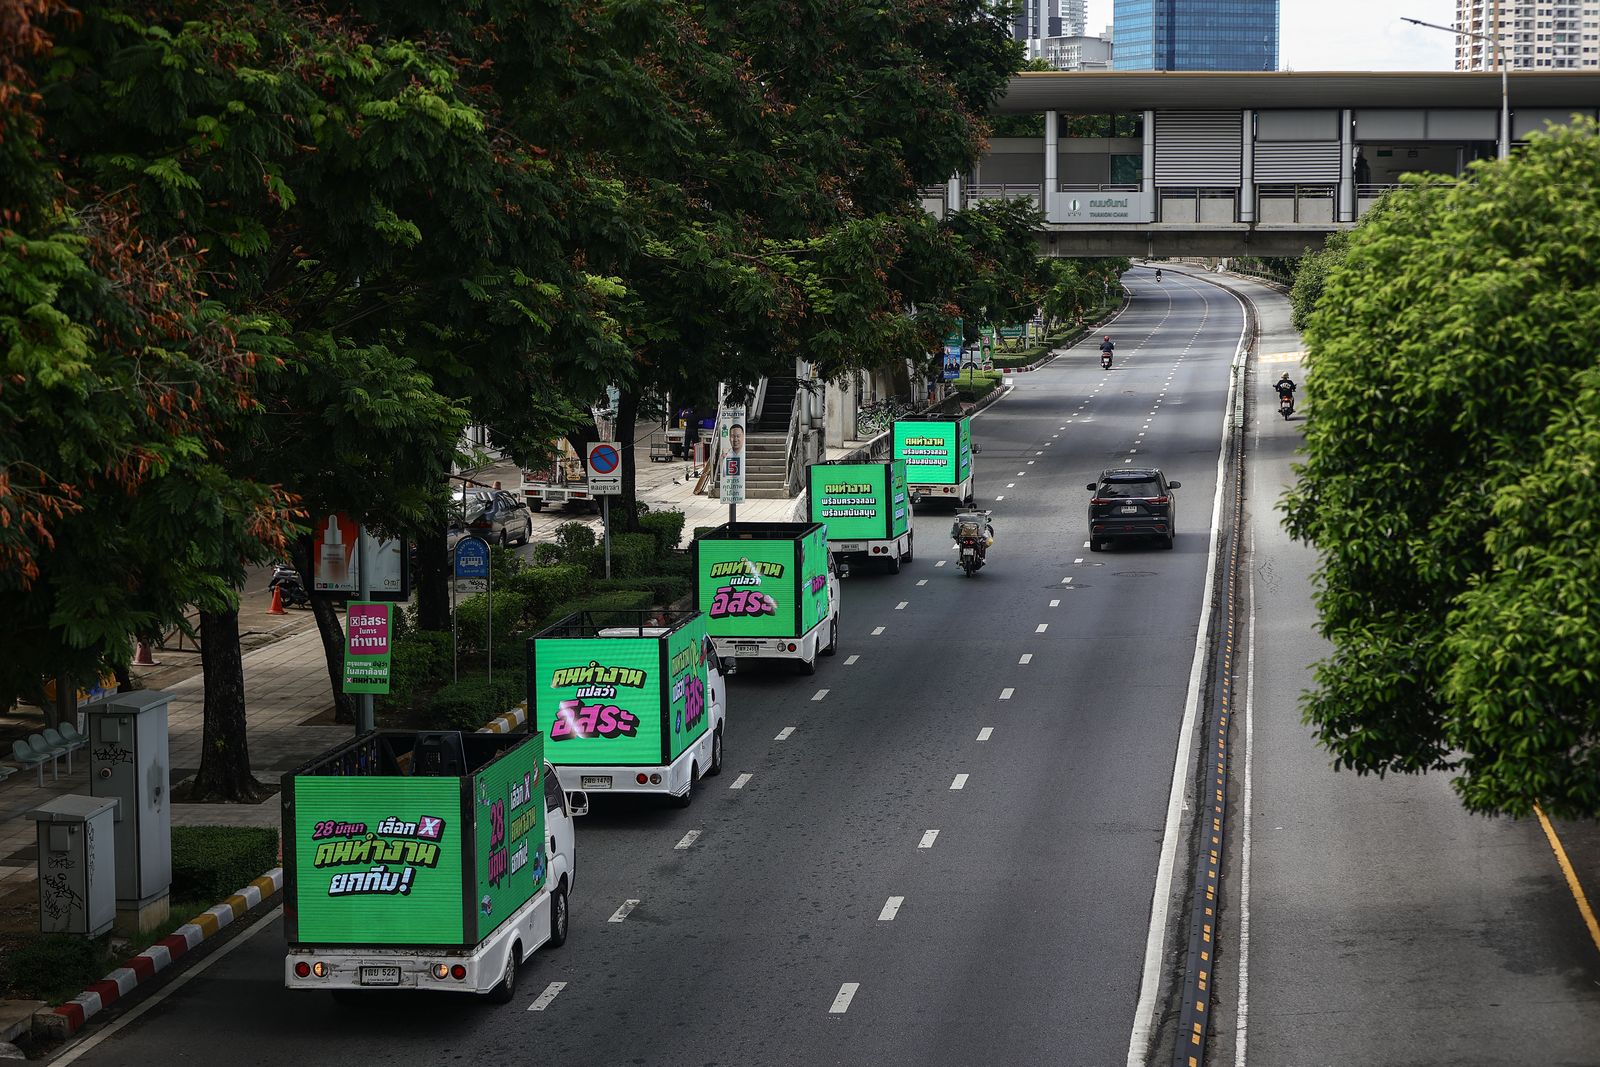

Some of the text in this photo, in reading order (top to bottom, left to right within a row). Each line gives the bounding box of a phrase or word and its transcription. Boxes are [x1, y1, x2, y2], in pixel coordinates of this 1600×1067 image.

[905, 436, 943, 446] คนทำงาน
[727, 460, 738, 475] 5
[825, 482, 871, 494] คนทำงาน
[821, 497, 875, 505] พร้อมตรวจสอบ
[822, 508, 875, 518] พร้อมสนับสนุน
[711, 557, 783, 577] คนทำงาน
[730, 576, 761, 586] แปลว่า
[710, 586, 777, 616] อิสระ
[360, 615, 387, 626] อิสระ
[351, 635, 387, 647] ทำงาน
[551, 661, 646, 688] คนทำงาน
[576, 685, 616, 698] แปลว่า
[551, 700, 637, 739] อิสระ
[313, 820, 335, 839] 28
[334, 822, 366, 838] มิถุนา
[377, 816, 417, 836] เลือก
[491, 799, 504, 848] 28
[314, 832, 439, 867] คนทำงาน
[488, 848, 507, 886] มิถุนา
[329, 865, 414, 895] ยกทีม!
[382, 968, 396, 976] 522
